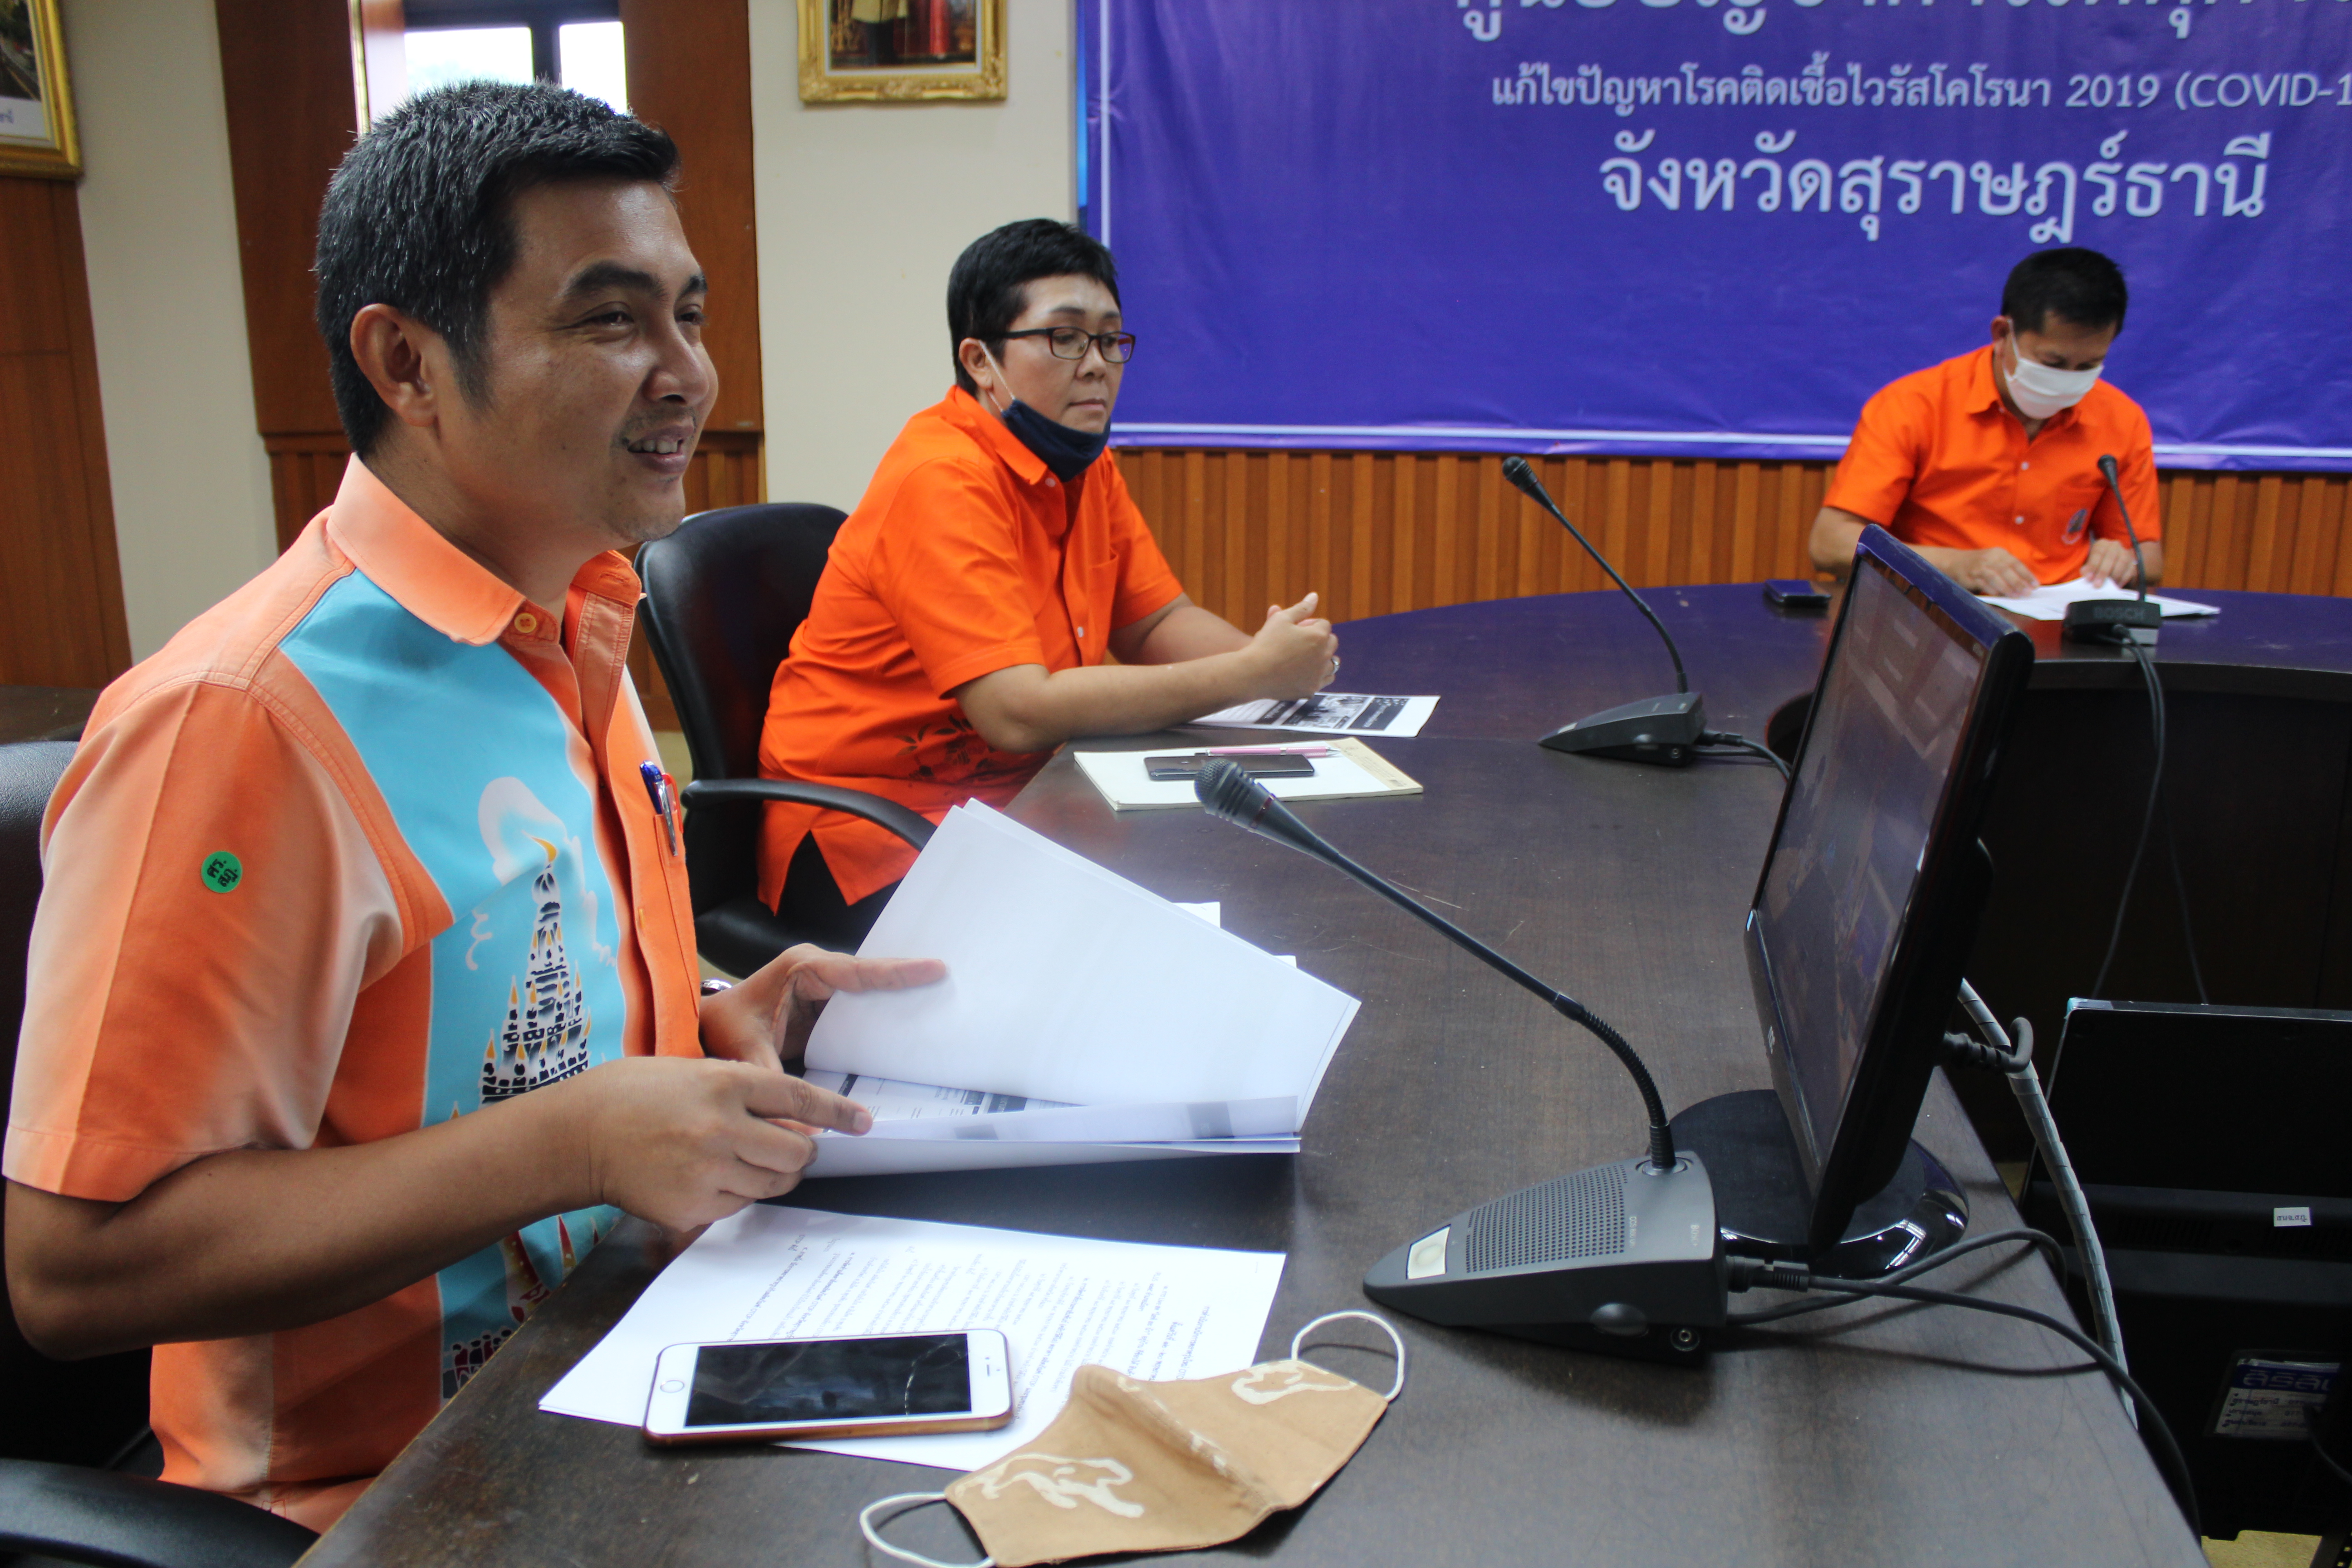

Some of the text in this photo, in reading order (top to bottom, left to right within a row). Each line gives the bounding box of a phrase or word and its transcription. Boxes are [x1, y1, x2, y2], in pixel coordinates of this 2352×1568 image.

[1491, 51, 2052, 117] แก้ไขปัญหาโรคติดเชื้อไวรัสโคโรนา
[2065, 73, 2160, 108] 2019
[1599, 129, 2272, 244] จังหวัดสุราษฎร์ธานี
[2093, 606, 2146, 621] BOSCH
